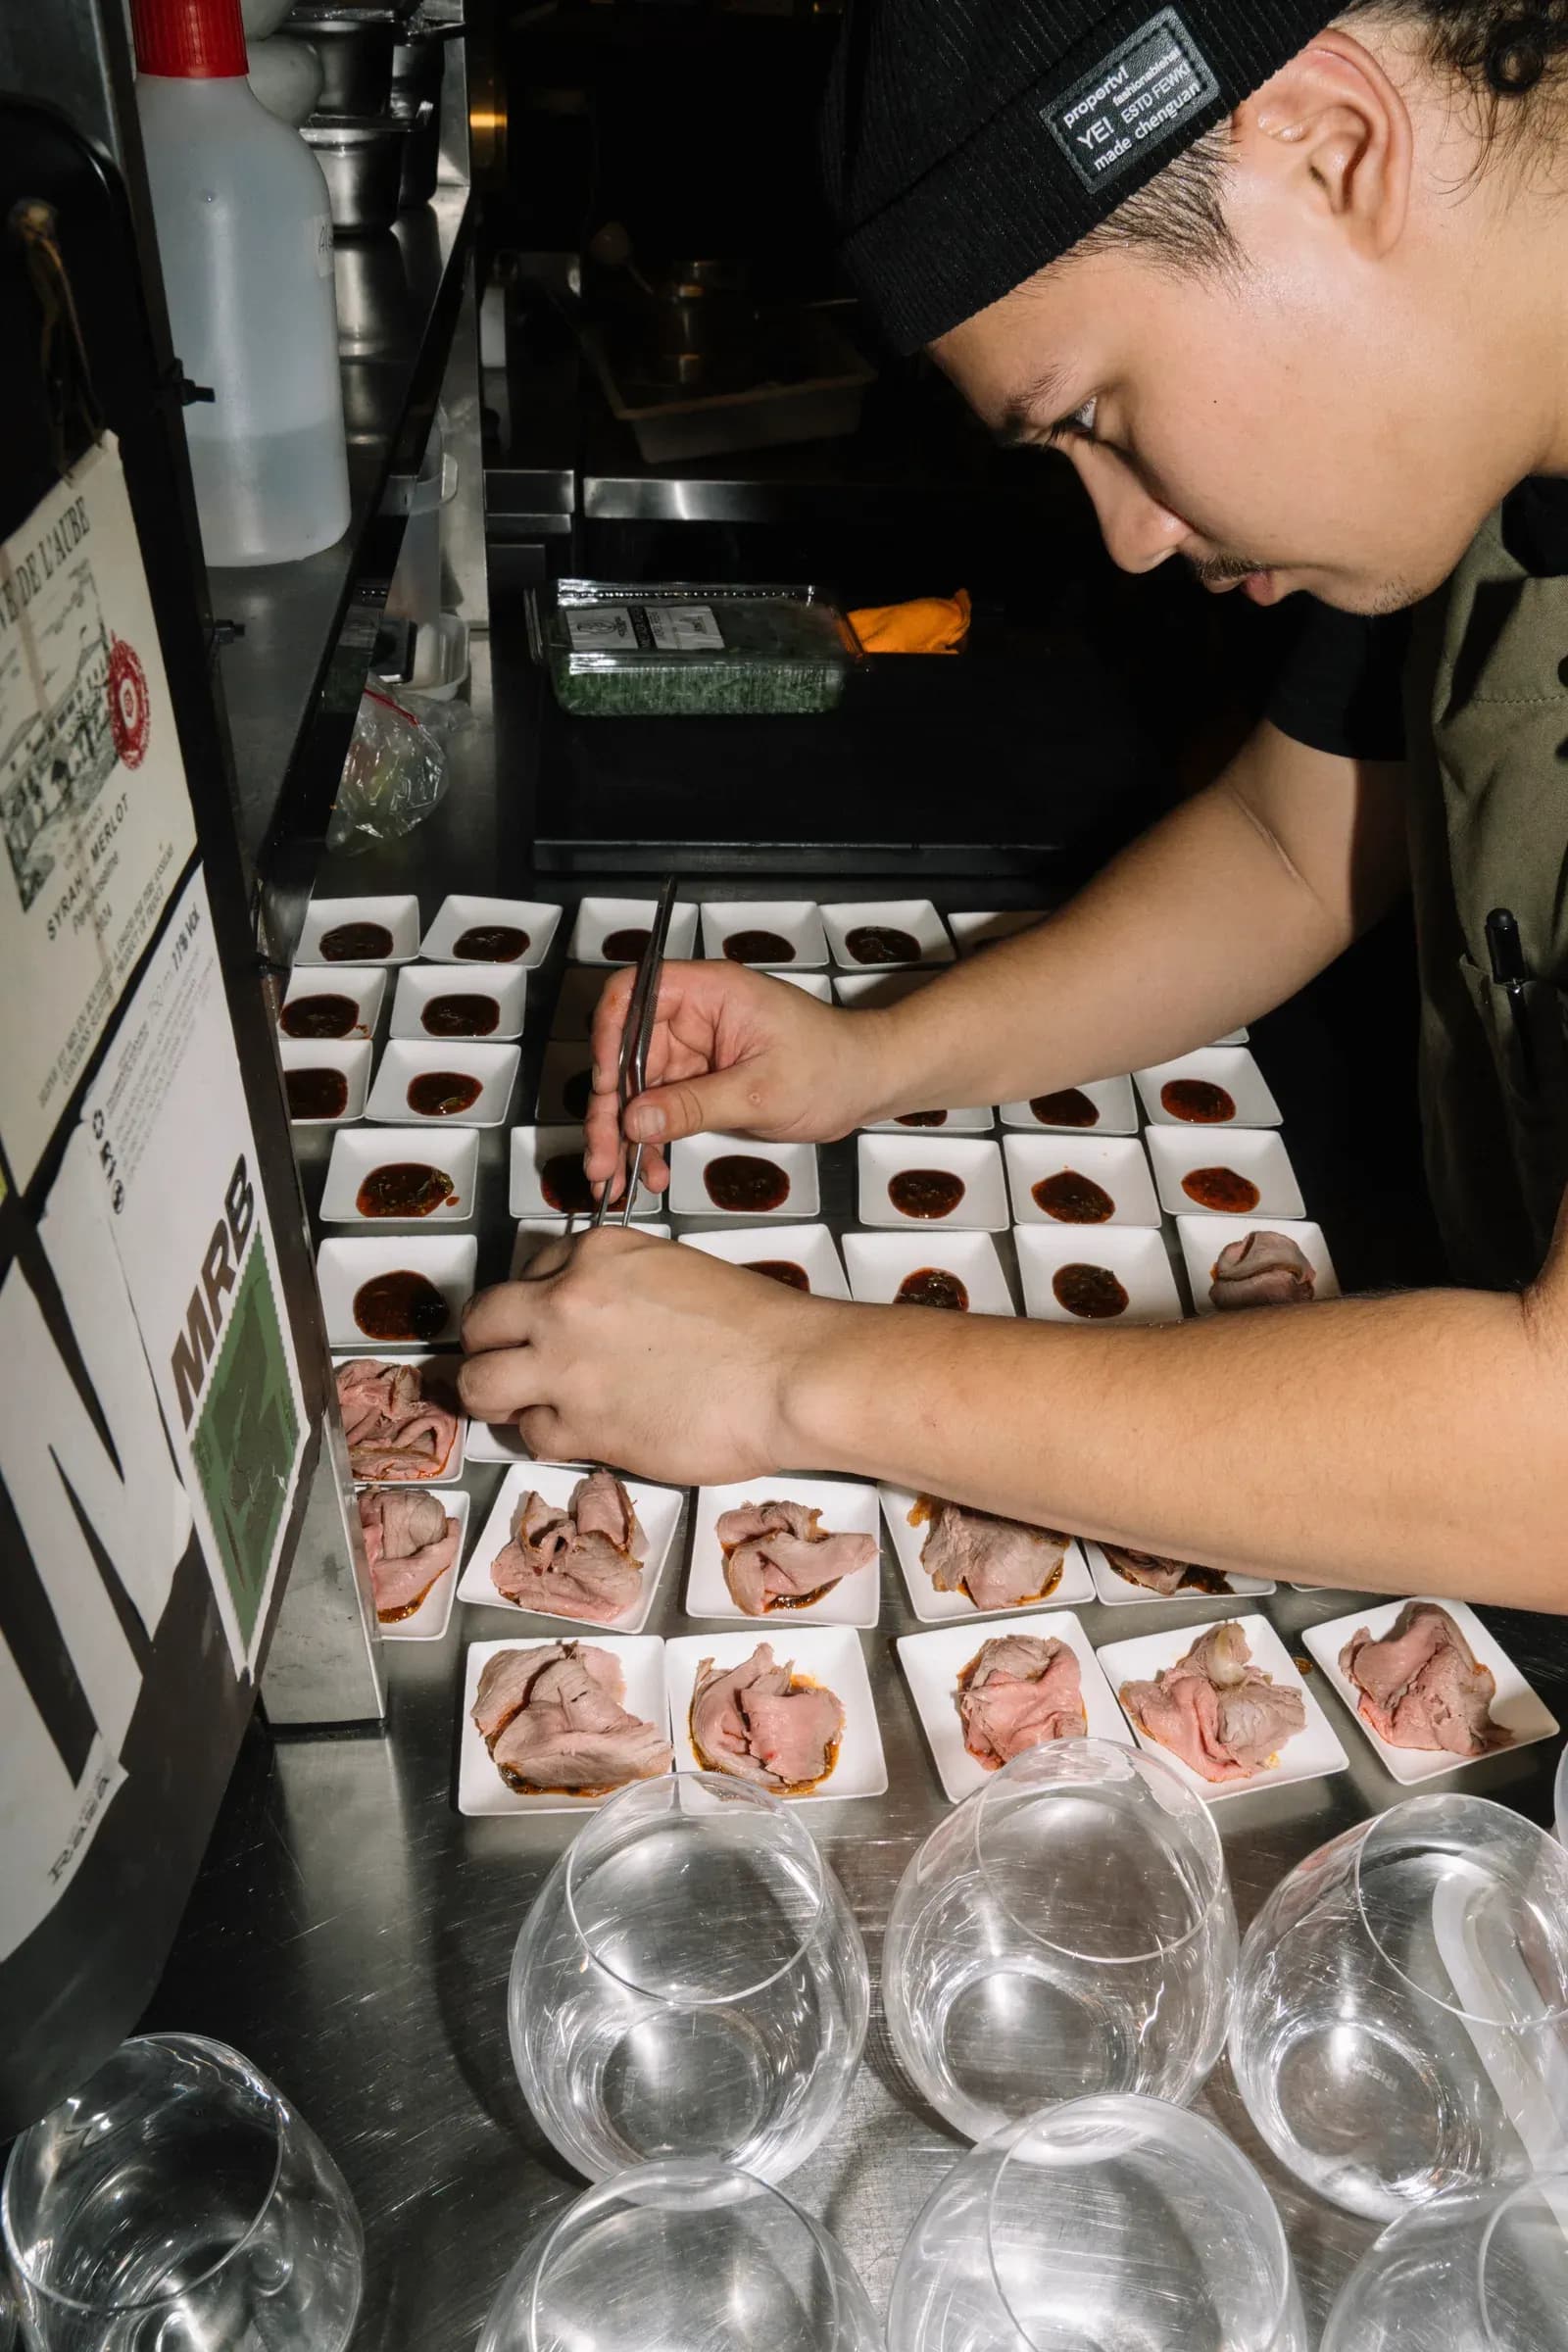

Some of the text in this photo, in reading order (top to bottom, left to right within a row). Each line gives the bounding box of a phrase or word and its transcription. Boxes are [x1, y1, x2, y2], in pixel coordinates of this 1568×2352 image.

[1077, 117, 1114, 150] YE!
[1120, 93, 1153, 123] ESTD
[1094, 81, 1200, 172] made chenguan
[46, 874, 83, 942] SYRAH
[90, 792, 129, 863] MERLOT
